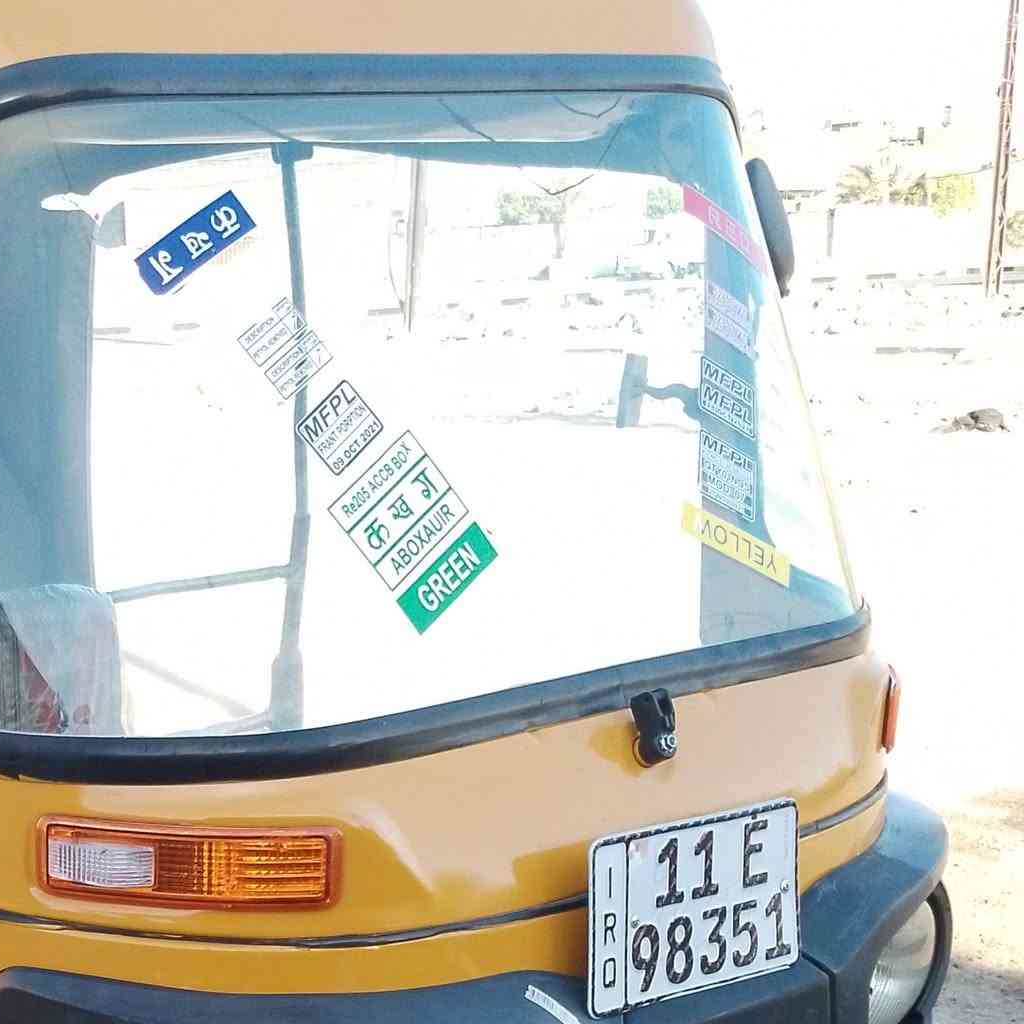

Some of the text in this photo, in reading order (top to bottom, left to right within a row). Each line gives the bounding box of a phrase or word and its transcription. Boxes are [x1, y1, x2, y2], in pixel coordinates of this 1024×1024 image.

[304, 388, 357, 443] MFPL
[343, 439, 361, 459] OCT
[391, 440, 413, 470] BOX
[417, 541, 481, 612] GREEN
[655, 818, 769, 908] 11 E
[631, 892, 792, 993] 98351
